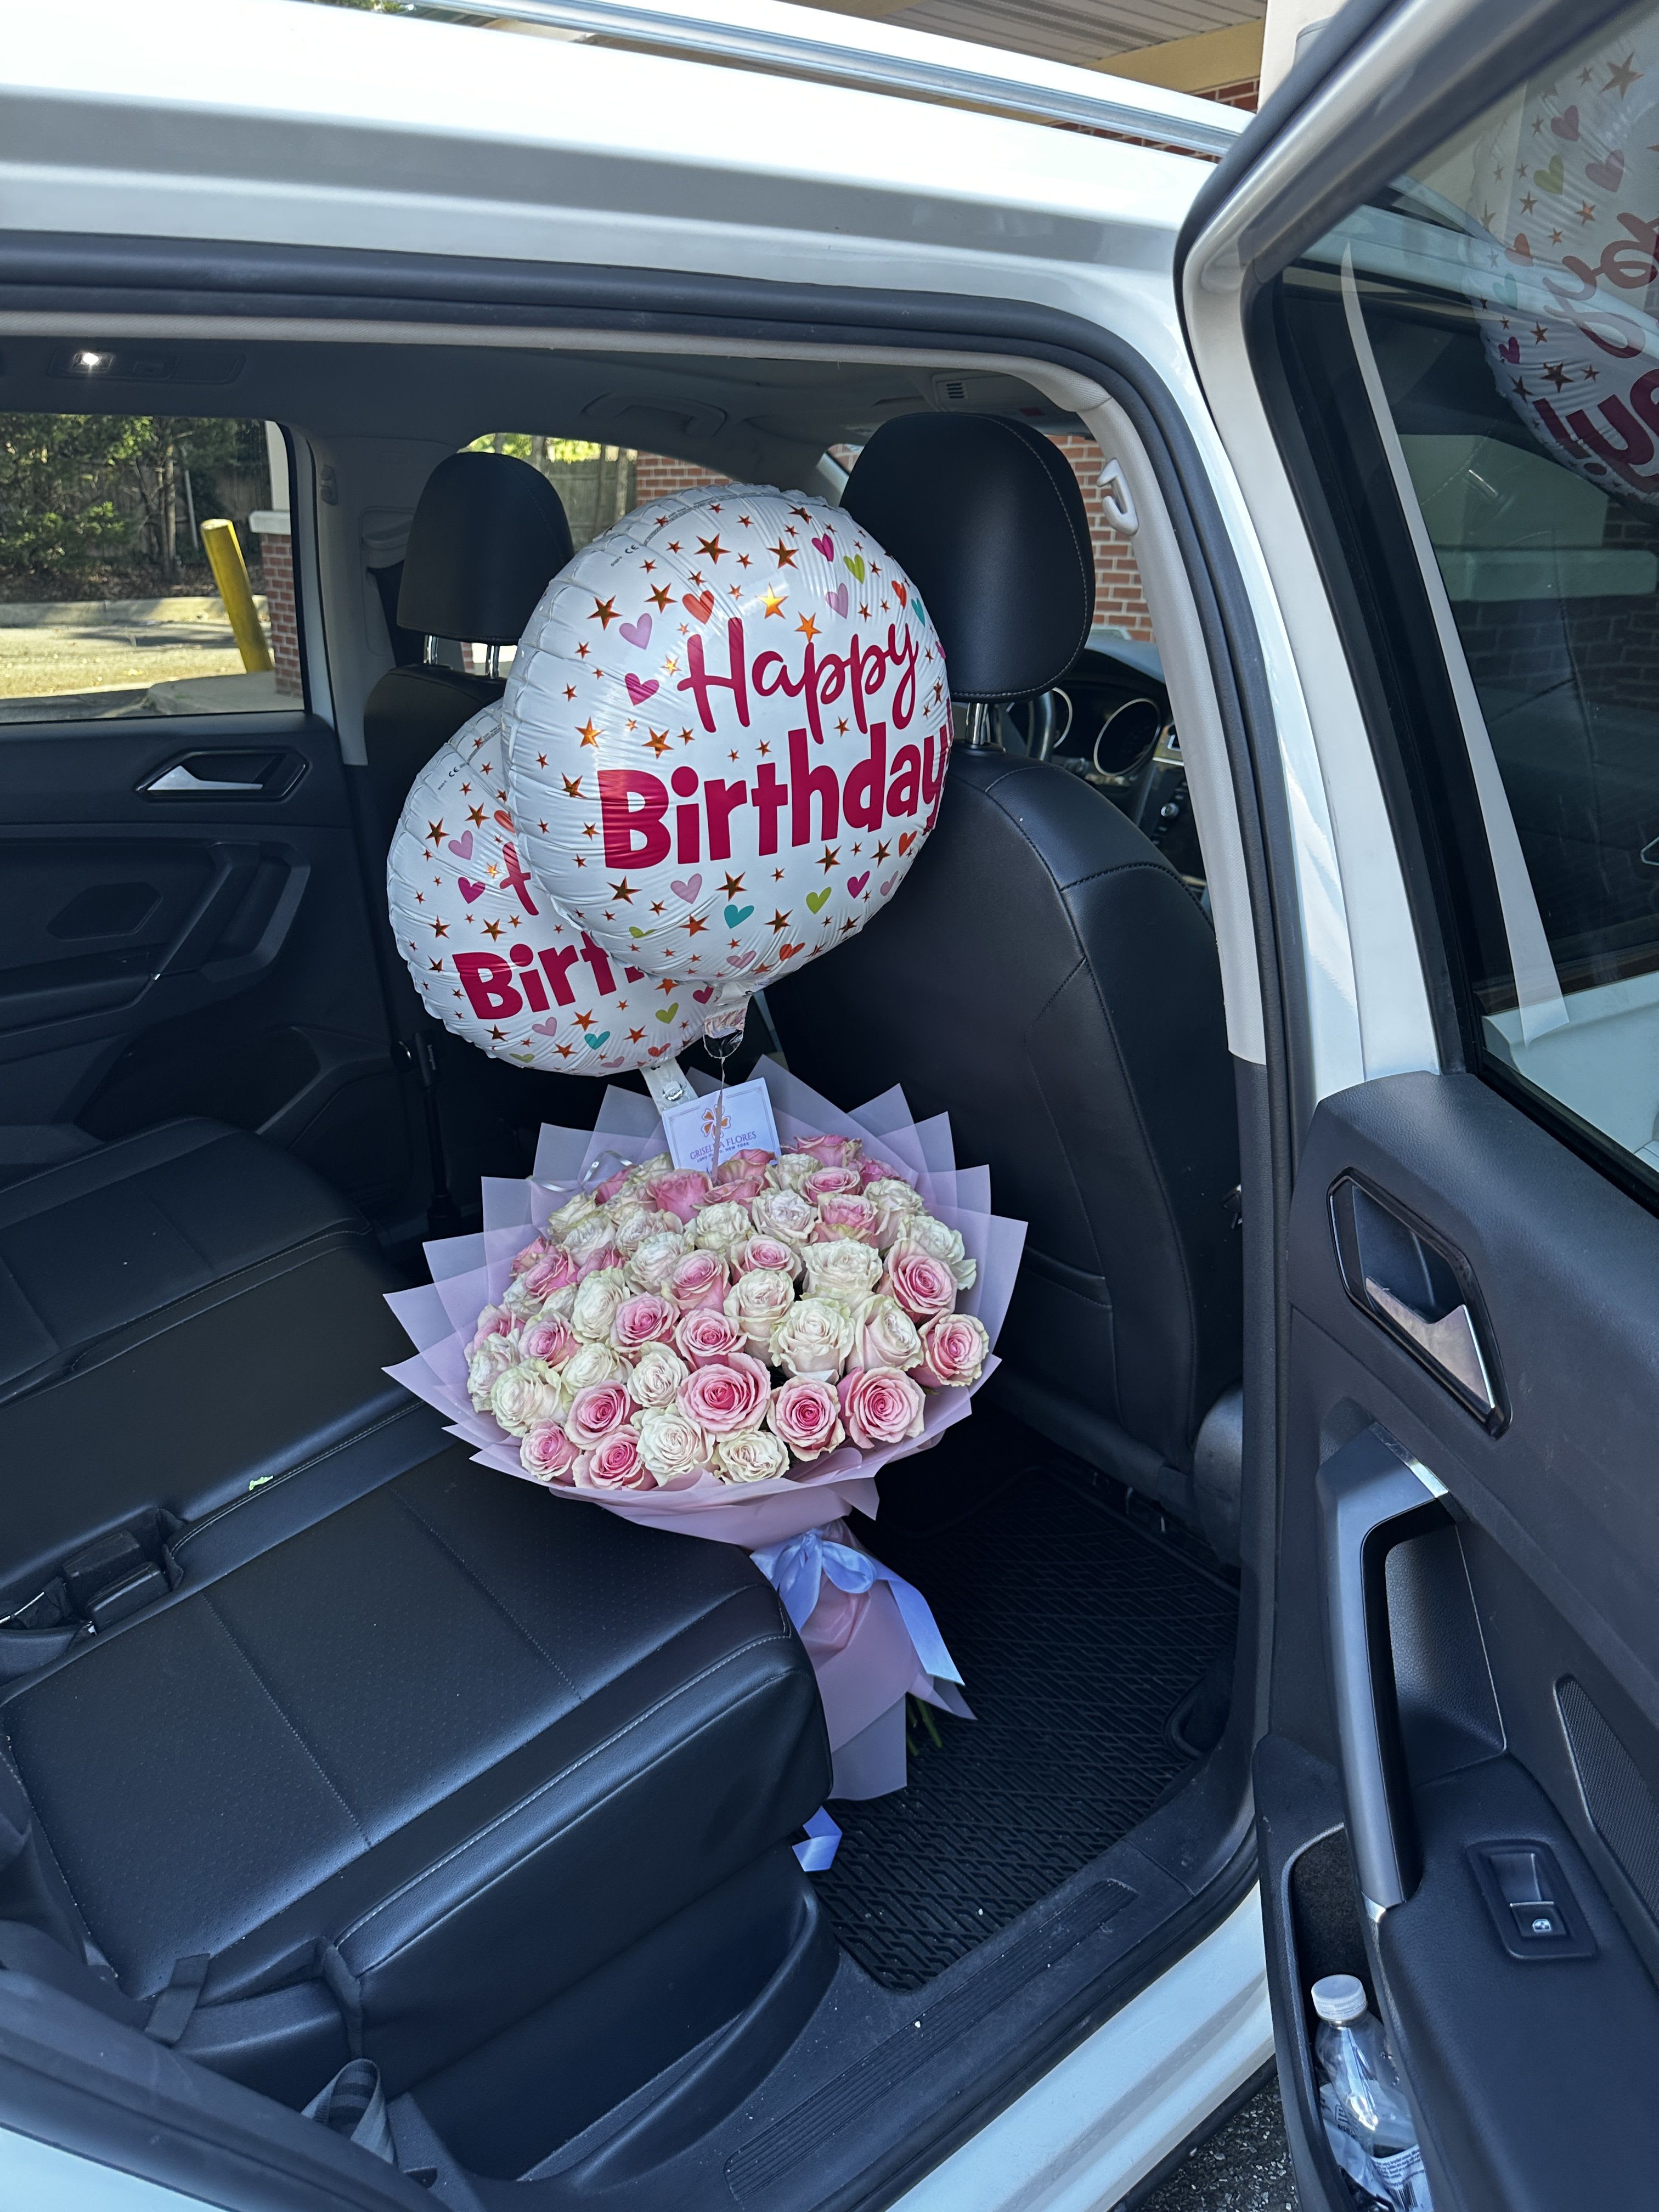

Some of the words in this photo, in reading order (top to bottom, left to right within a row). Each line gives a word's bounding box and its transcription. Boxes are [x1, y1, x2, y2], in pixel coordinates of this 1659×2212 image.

[678, 617, 919, 744] Happy
[452, 930, 645, 1019] Birt
[690, 1142, 725, 1160] GRISELA
[726, 1131, 757, 1147] FLORES
